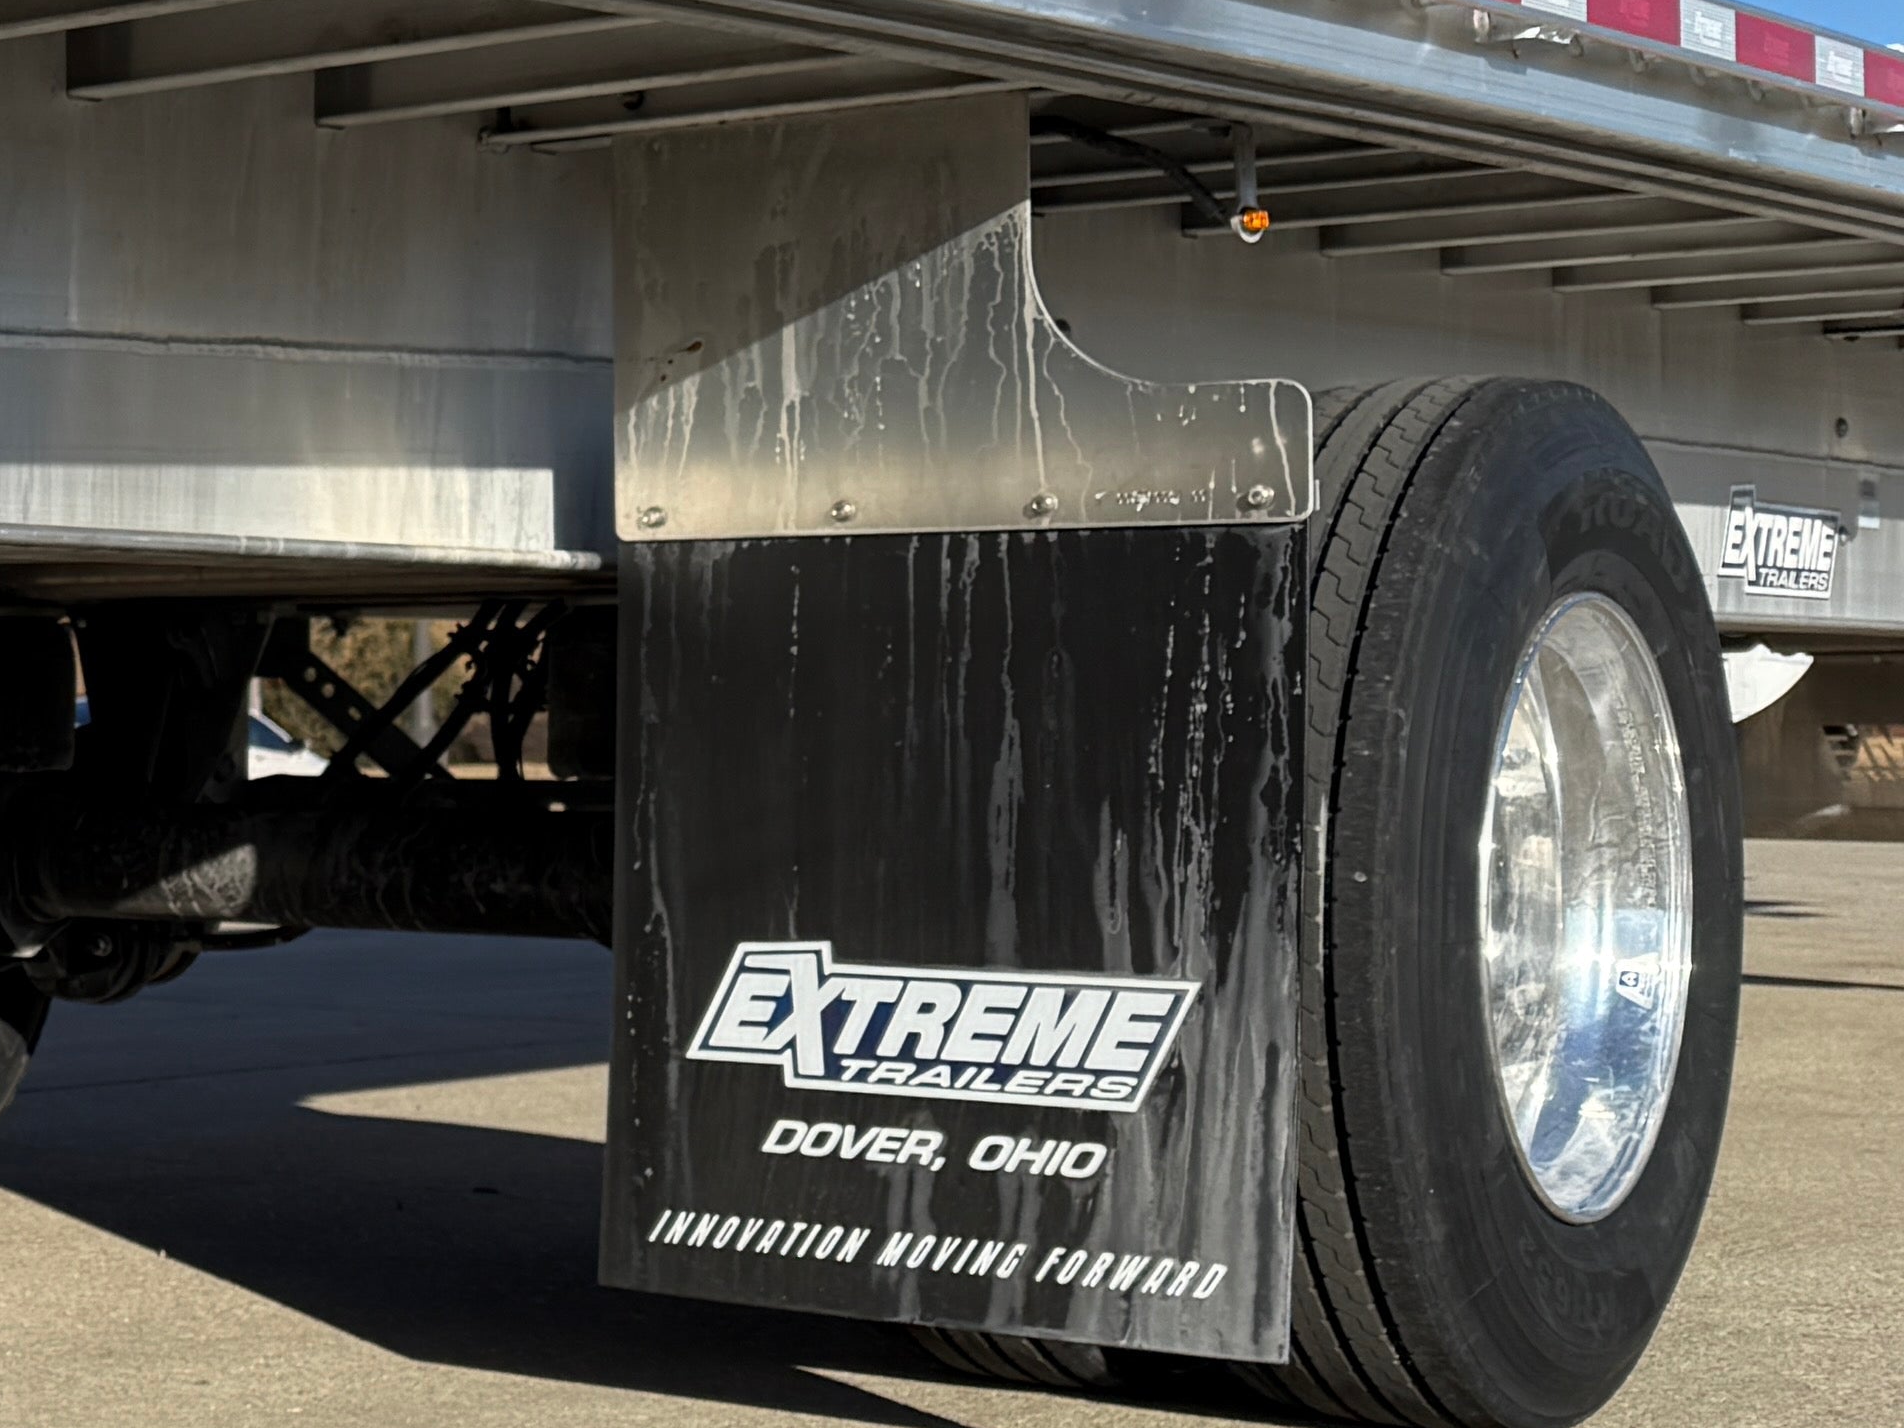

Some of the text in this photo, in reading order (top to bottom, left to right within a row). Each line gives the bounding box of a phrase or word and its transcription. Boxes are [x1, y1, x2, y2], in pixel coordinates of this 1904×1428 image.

[1724, 492, 1836, 581] EXTREME
[1757, 566, 1829, 591] TRAILERS
[709, 952, 1176, 1076] EXTREME
[838, 1058, 1139, 1101] TRAILERS
[760, 1119, 1108, 1179] DOVER, OHIO
[647, 1208, 1229, 1301] INNOVATION MOVING FORWARD
